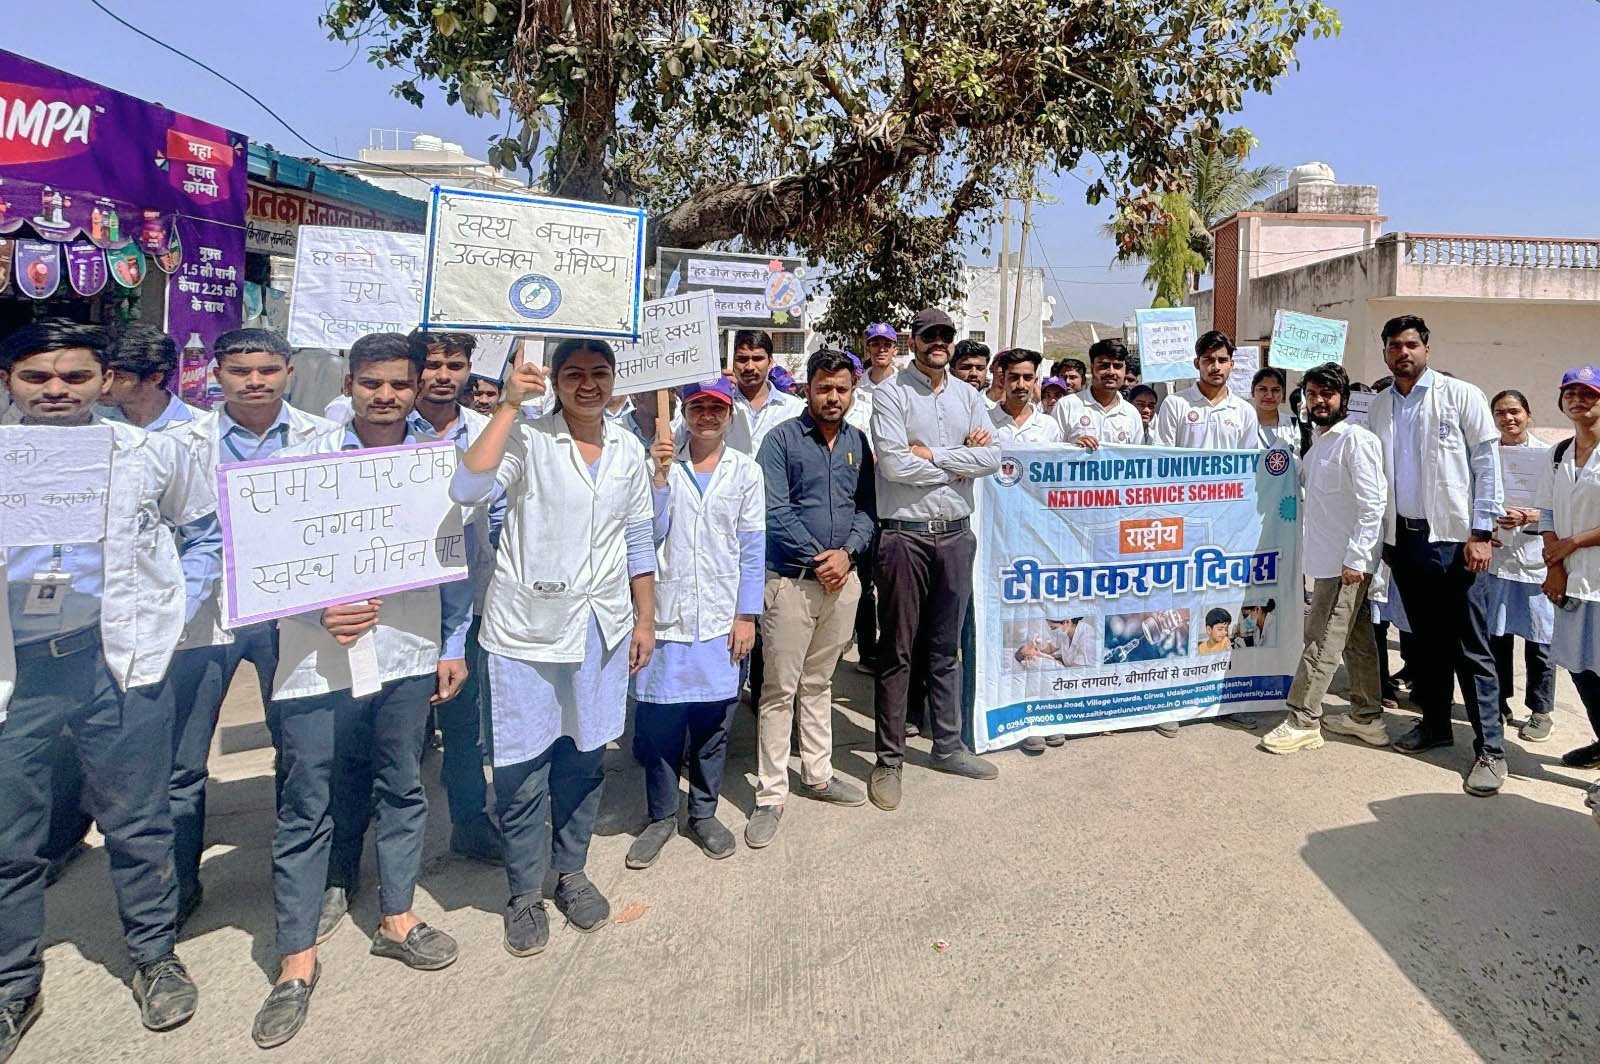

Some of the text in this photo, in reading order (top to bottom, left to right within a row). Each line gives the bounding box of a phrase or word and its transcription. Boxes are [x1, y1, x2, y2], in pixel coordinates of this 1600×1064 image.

[0, 96, 91, 148] MPA
[188, 142, 214, 161] महा
[186, 163, 217, 180] बचत
[456, 214, 517, 240] स्वस्थ
[536, 222, 606, 248] बचपन
[310, 250, 332, 266] हर
[390, 254, 418, 272] का
[445, 243, 539, 270] उज्जवल
[182, 262, 199, 276] 1.5
[215, 265, 237, 281] पानी
[203, 301, 225, 313] साथ
[643, 299, 692, 323] ाकरण
[737, 300, 752, 311] पूरी
[665, 320, 705, 340] स्वस्थ
[615, 354, 662, 378] समाज
[1029, 461, 1062, 482] SAI
[1067, 456, 1154, 482] TIRUPATI
[1157, 453, 1260, 478] UNIVERSITY
[237, 463, 342, 513] समय
[350, 456, 403, 492] पर
[1047, 482, 1244, 508] NATIONAL SERVICE SCHEME
[0, 493, 29, 509] रण
[293, 505, 400, 545] लगवाए
[1124, 523, 1177, 550] राष्ट्रीय
[252, 553, 339, 593] स्वस्थ
[354, 536, 429, 575] जीवन
[1001, 548, 1279, 600] टीकाकरण दिवस
[1052, 678, 1078, 692] टीका
[1125, 667, 1168, 684] बीमारियों
[1171, 666, 1179, 678] से
[1182, 663, 1208, 677] बचाव
[1035, 703, 1062, 711] Ambua
[1086, 698, 1111, 708] Village
